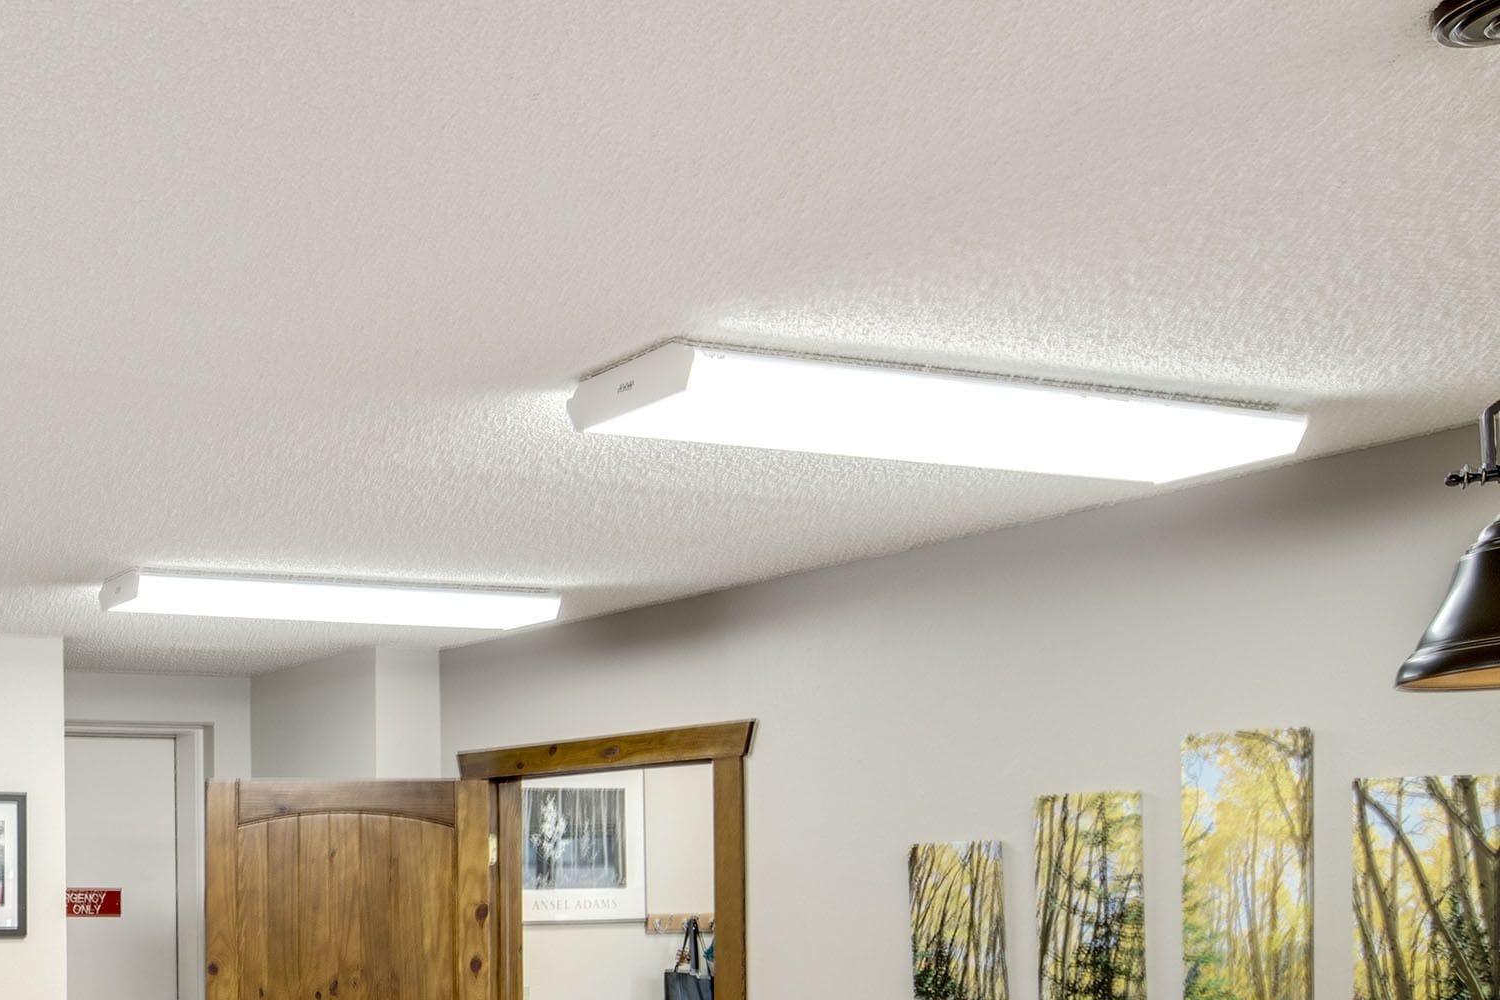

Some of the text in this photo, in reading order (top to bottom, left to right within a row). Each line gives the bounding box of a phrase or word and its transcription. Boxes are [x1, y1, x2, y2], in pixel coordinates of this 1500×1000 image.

[73, 904, 102, 915] ONLY
[532, 898, 619, 911] ANSEL ADAMS
